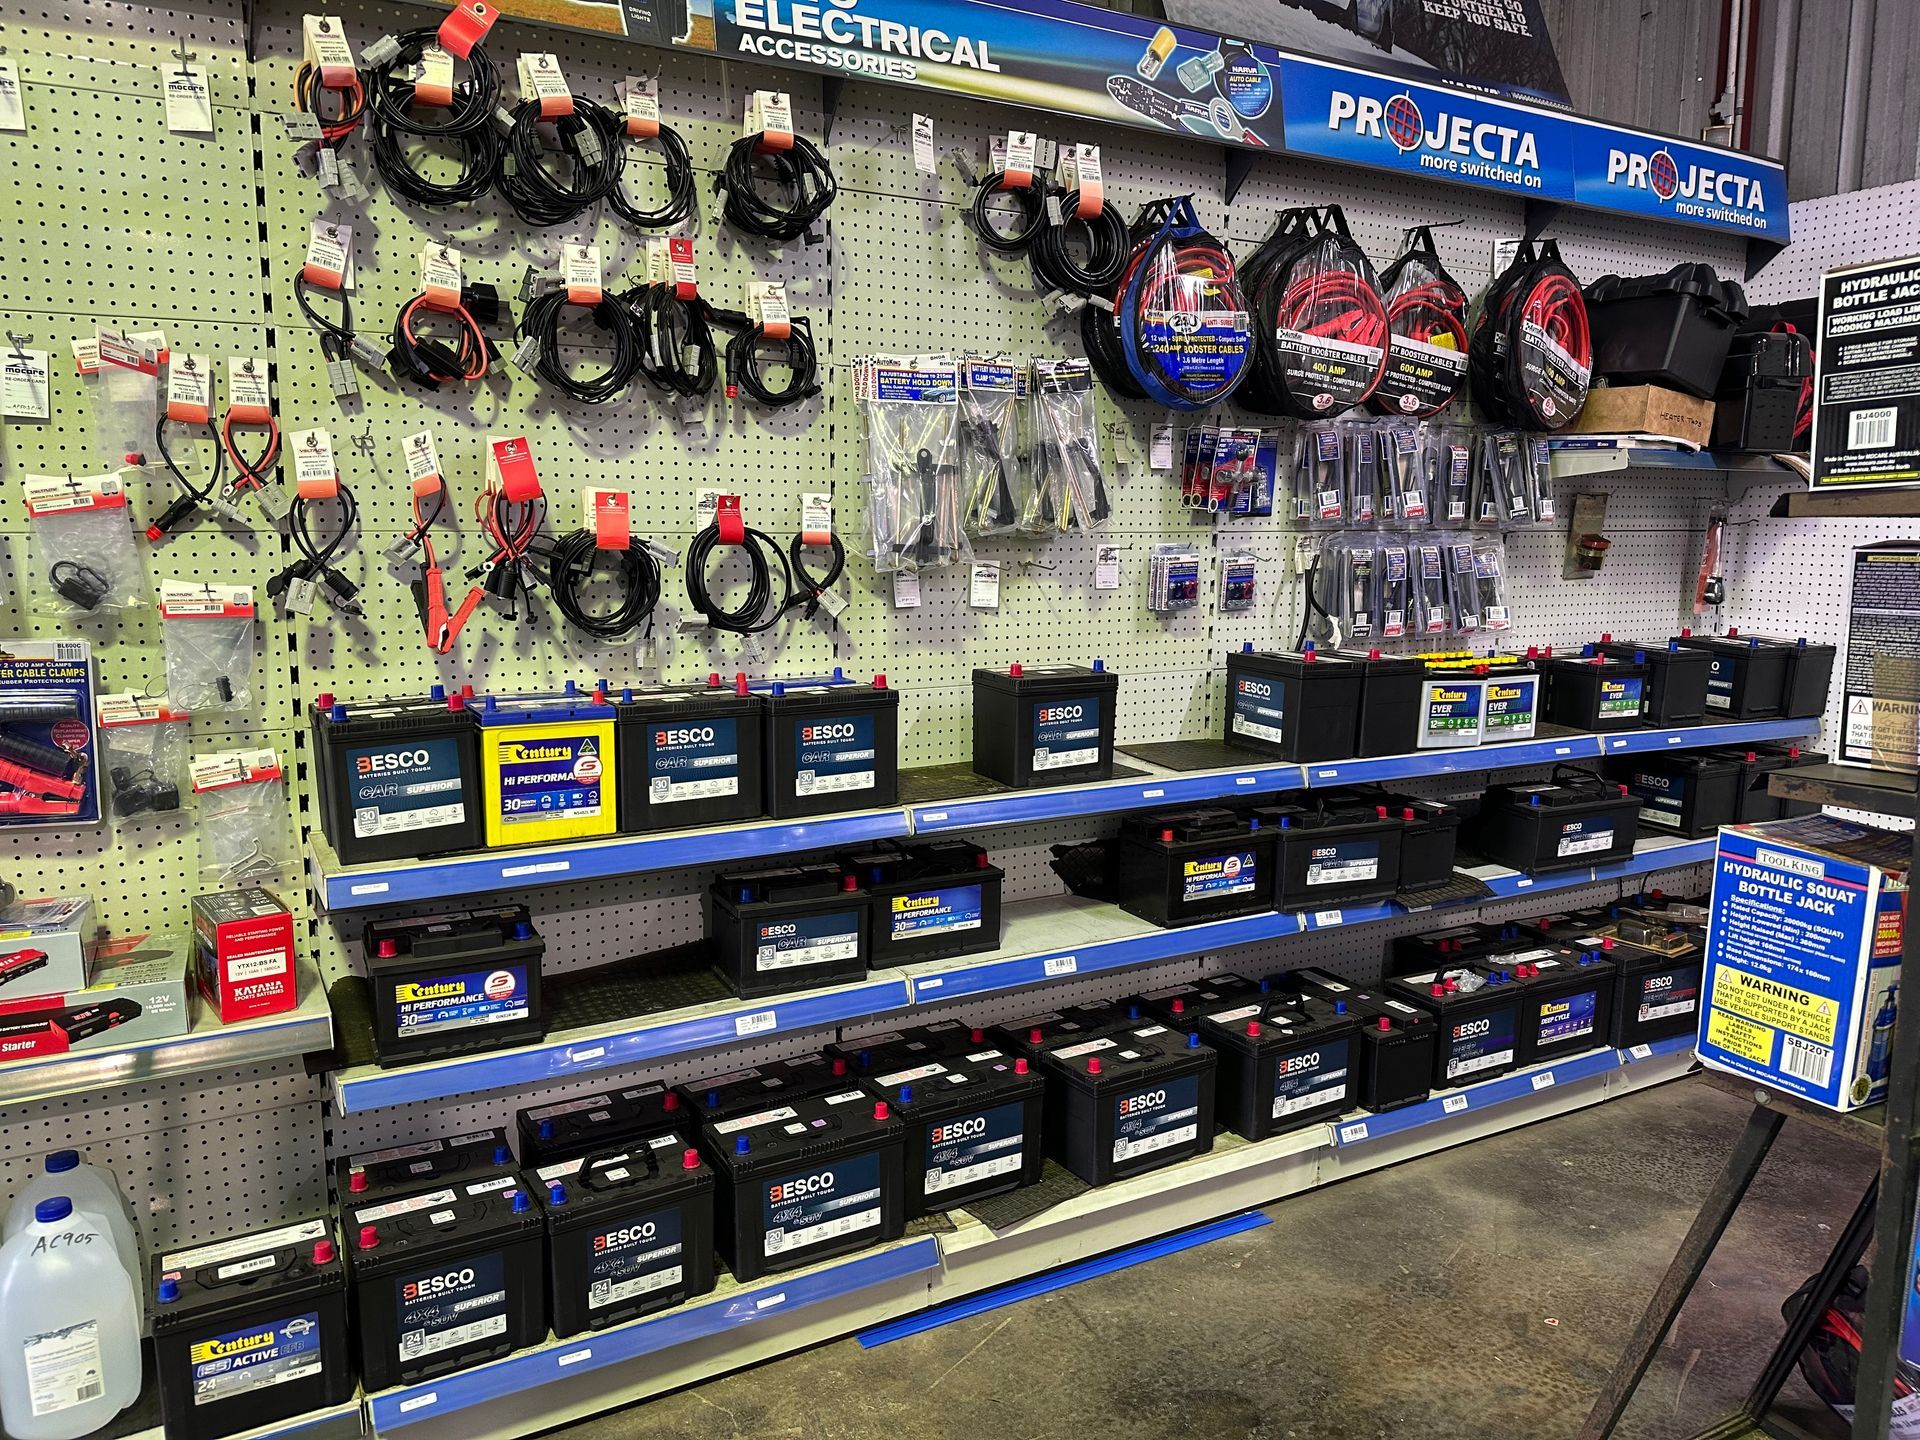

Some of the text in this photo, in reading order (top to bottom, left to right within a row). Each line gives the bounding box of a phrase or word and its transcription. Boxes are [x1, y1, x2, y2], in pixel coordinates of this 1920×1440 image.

[631, 13, 651, 22] LIGHTS
[1422, 0, 1533, 37] KEEP YOU SAFE.
[736, 0, 1001, 72] ELECTRICAL
[738, 33, 917, 79] ACCESSORIES
[168, 84, 204, 93] mocare
[1185, 105, 1209, 118] NARVA
[1329, 90, 1539, 169] PROJECTA
[1420, 153, 1541, 189] more switched on
[1608, 147, 1764, 212] PROJECTA
[1676, 202, 1766, 229] more switched on
[1841, 269, 1920, 293] HYDRAULIC
[1833, 284, 1920, 309] BOTTLE JAC
[1832, 312, 1875, 325] WORKING
[1877, 308, 1902, 318] LOAD
[1830, 321, 1871, 333] 4000KG
[1155, 345, 1169, 353] 240
[1184, 345, 1217, 353] BOOSTER
[1218, 345, 1244, 353] CABLES
[1281, 341, 1365, 363] BATTERY BOOSTER CABLES
[1400, 348, 1429, 362] BOOSTER
[1430, 357, 1453, 368] CABLES
[5, 366, 45, 375] mocare
[972, 364, 988, 372] BATTERY
[1312, 362, 1346, 375] 400 AMP
[1400, 363, 1433, 378] 600 AMP
[1317, 395, 1332, 405] 3.6
[1403, 395, 1417, 406] 3.6
[1660, 411, 1684, 422] HEATER
[1856, 411, 1891, 420] BJ4000
[16, 668, 85, 678] CABLE CLAMPS
[1238, 680, 1271, 697] BESCO
[1039, 705, 1083, 721] BESCO
[1257, 707, 1281, 717] SUPERIOR
[655, 727, 714, 745] BESCO
[802, 723, 854, 741] BESCO
[1065, 730, 1095, 740] SUPERIOR
[356, 749, 430, 774] BESCO
[655, 756, 731, 770] CAR SUPERIOR
[802, 751, 869, 764] CAR SUPERIOR
[517, 772, 576, 784] PERFORMA
[655, 780, 666, 789] 30
[1634, 773, 1670, 788] BESCO
[359, 781, 454, 800] CAR SUPERIOR
[504, 799, 520, 811] 30
[361, 812, 375, 822] 30
[1562, 822, 1582, 831] BESCO
[1312, 848, 1337, 858] BESCO
[1349, 859, 1374, 867] SUPERIOR
[1723, 861, 1856, 905] HYDRAULIC SQUAT
[1739, 880, 1835, 916] BOTTLE JACK
[1730, 911, 1831, 944] Height Lowered (Min) 200mm
[1731, 903, 1844, 939] Rated Capacity: 20000kg (SQUAT)
[761, 924, 796, 937] BESCO
[817, 935, 852, 945] SUPERIOR
[234, 981, 283, 996] KATANA
[409, 982, 465, 997] Century
[1740, 974, 1810, 1007] WARNING
[150, 995, 170, 1004] 12V
[413, 993, 484, 1012] PERFORMANCE
[1717, 982, 1831, 1025] DO NOT GET UNDER A VEHICLE
[1554, 1013, 1570, 1022] CYCLE
[1714, 997, 1831, 1043] USE VEHICLE SUPPORT STANDS
[1716, 990, 1831, 1034] THAT IS SUPPORTED BY A JACK
[400, 1014, 418, 1027] 30
[1453, 1019, 1489, 1038] BESCO
[1717, 1011, 1767, 1033] READ WARNING
[1728, 1021, 1752, 1034] LABELS
[2, 1040, 36, 1052] Starter
[1787, 1037, 1830, 1058] SBJ20T
[1279, 1052, 1320, 1074] BESCO
[1320, 1069, 1345, 1083] SUPERIOR
[1120, 1090, 1166, 1114] BESCO
[1167, 1109, 1194, 1122] SUPERIOR
[932, 1117, 986, 1143] BESCO
[770, 1172, 834, 1202] BESCO
[773, 1191, 874, 1224] 4X4 SUPERIOR
[593, 1221, 656, 1251] BESCO
[770, 1232, 781, 1241] 20
[31, 1234, 99, 1256] AC905
[593, 1246, 677, 1274] 4X4 SUPERIOR
[403, 1268, 475, 1300] BESCO
[595, 1283, 607, 1294] 24
[404, 1293, 500, 1324] 4X4 SUPERIOR
[206, 1331, 274, 1355] Century
[406, 1334, 420, 1346] 24
[233, 1348, 279, 1368] ACTIVE
[198, 1379, 217, 1393] 24
